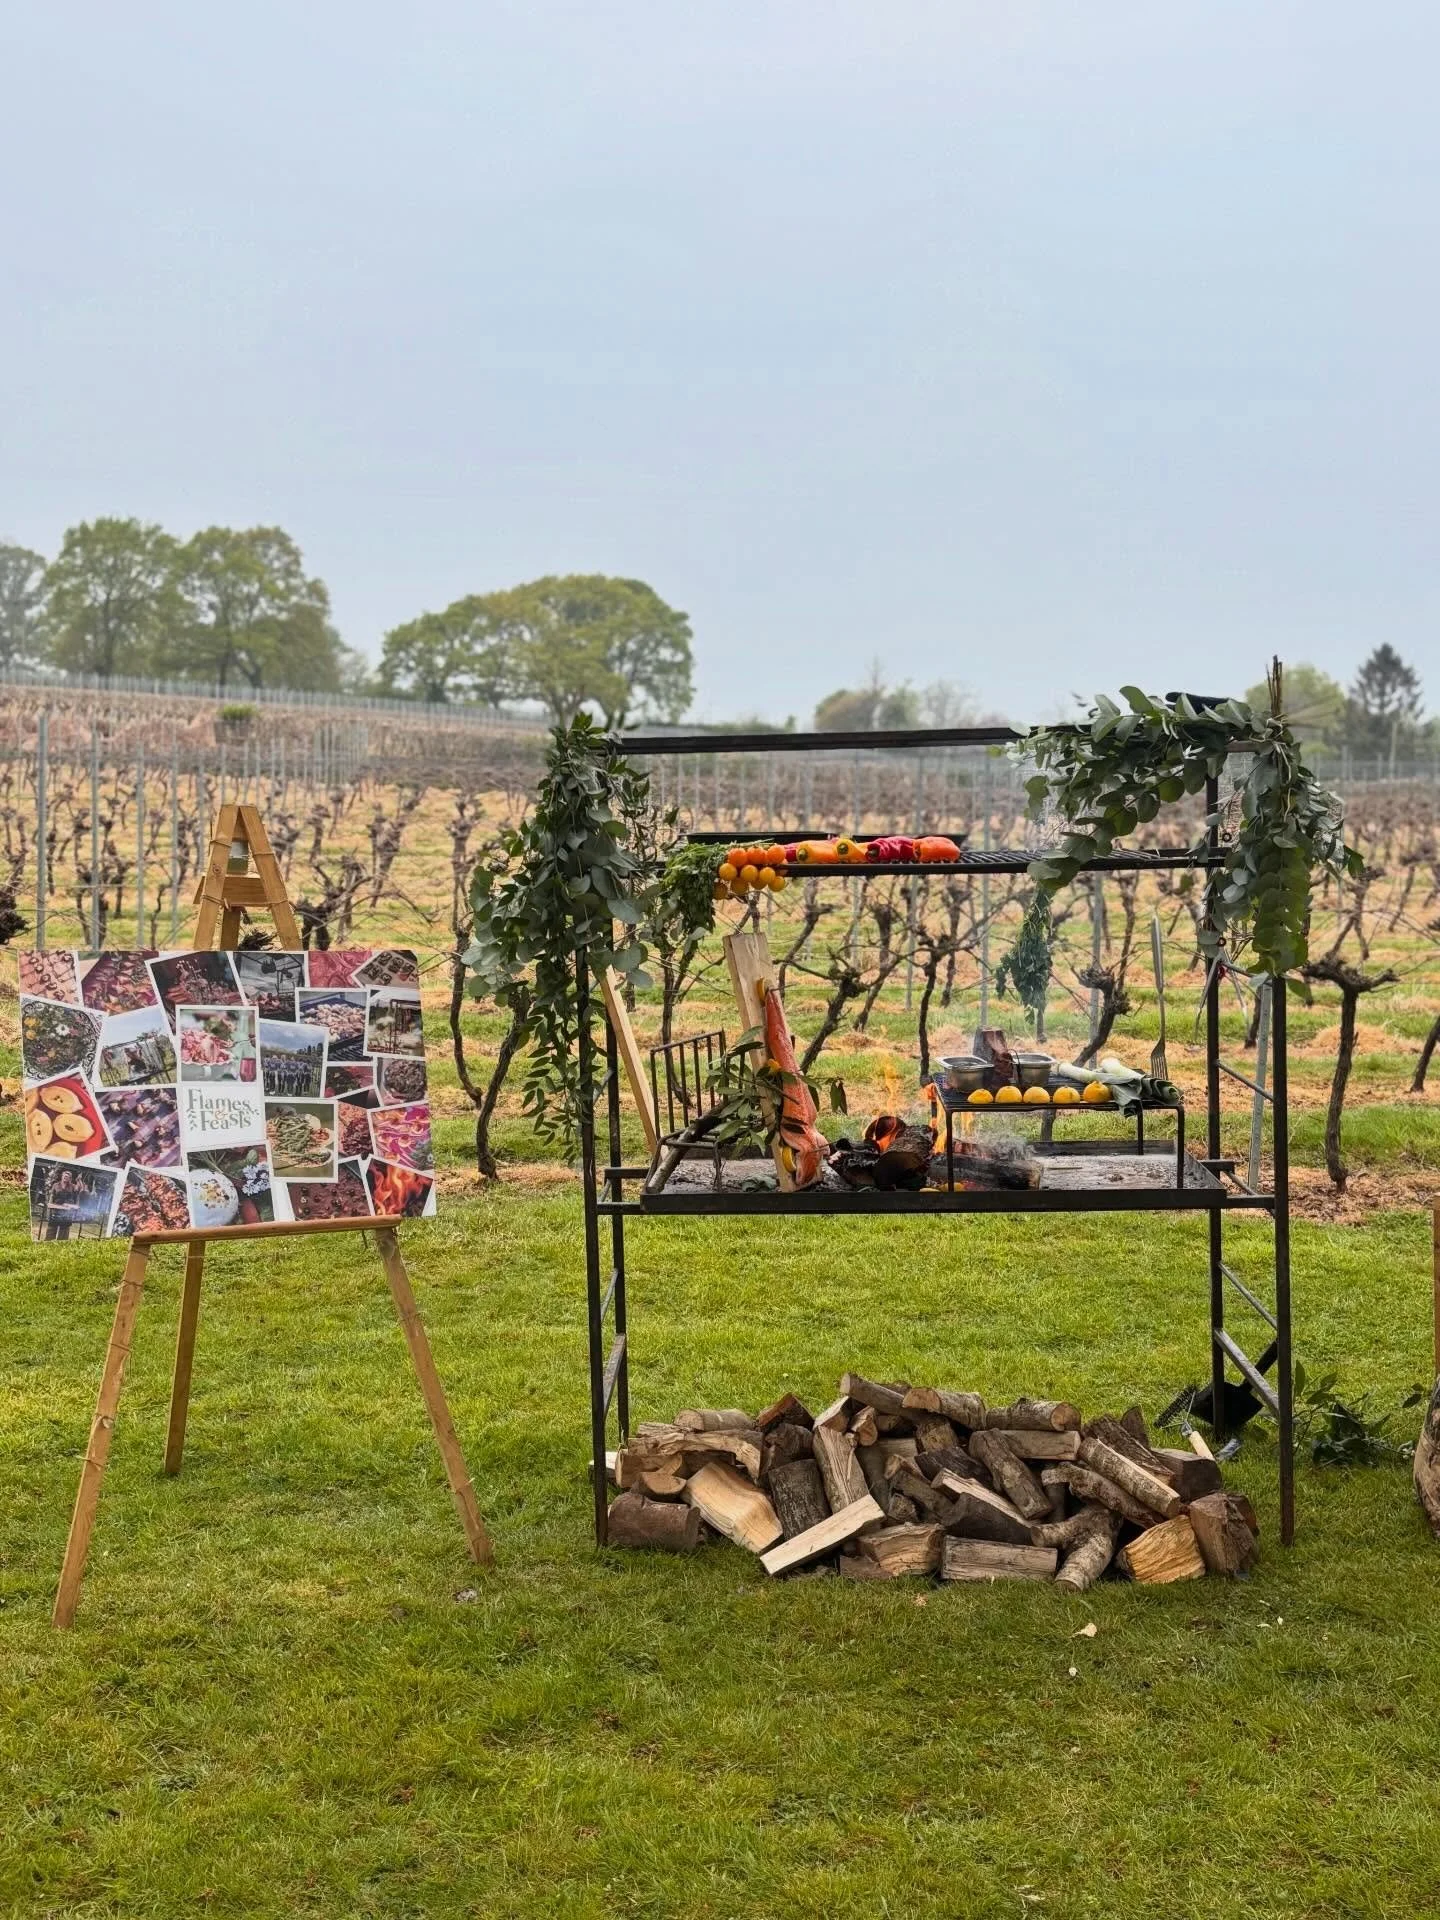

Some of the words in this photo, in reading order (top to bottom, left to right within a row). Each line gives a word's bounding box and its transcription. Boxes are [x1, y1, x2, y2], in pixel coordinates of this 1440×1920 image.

[187, 1088, 250, 1112] Flames
[200, 1110, 251, 1131] Feasts
[214, 1108, 228, 1120] &
